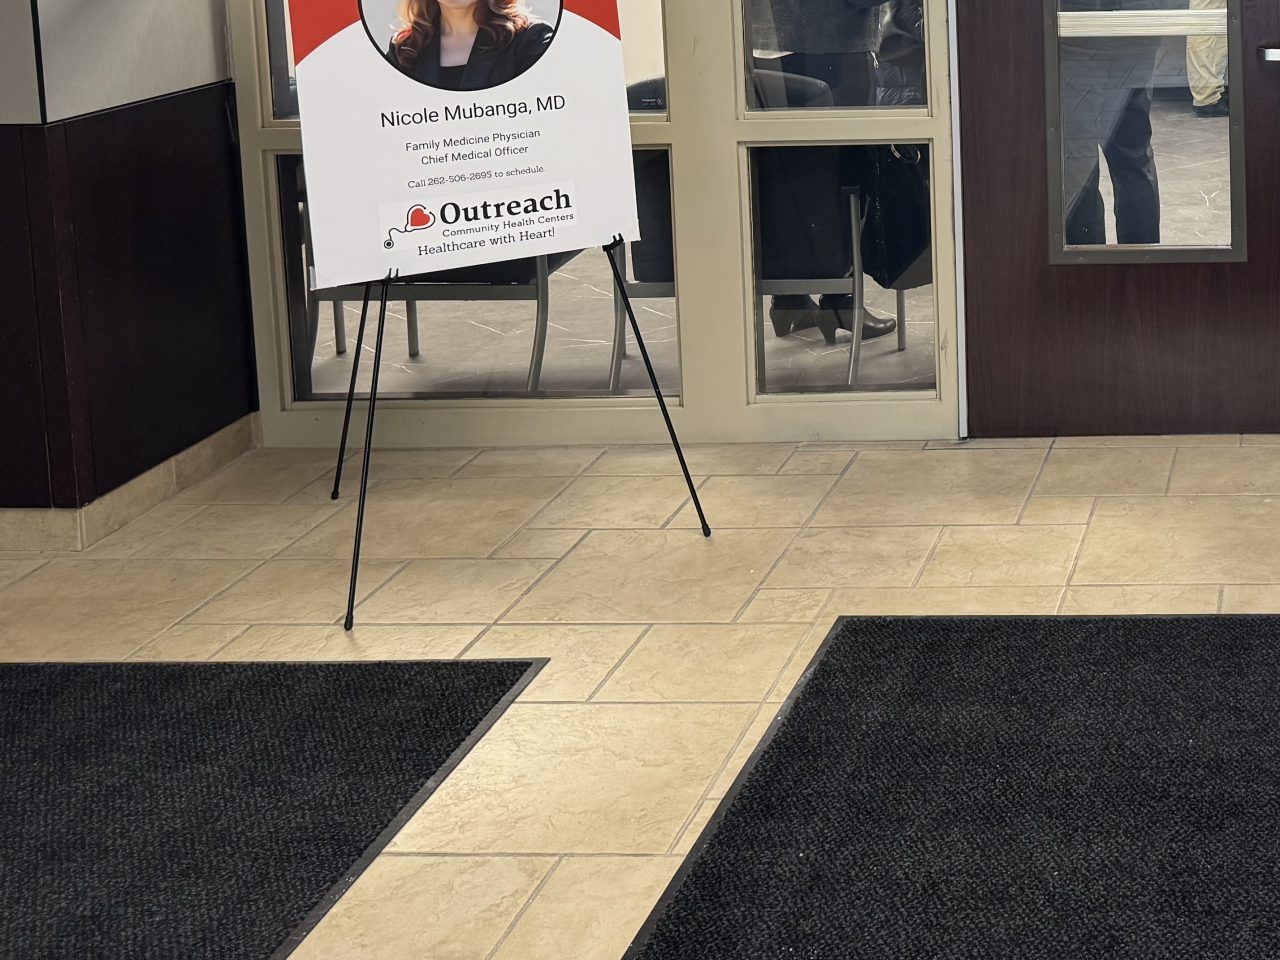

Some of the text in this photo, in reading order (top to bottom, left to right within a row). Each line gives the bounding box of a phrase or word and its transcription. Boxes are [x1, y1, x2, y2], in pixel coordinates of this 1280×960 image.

[380, 95, 566, 128] Nicole Mubanga, MD
[405, 128, 541, 152] Family Medicine Physician
[421, 144, 529, 165] Chief Medical Officer
[407, 179, 426, 189] Call
[427, 170, 493, 186] 262-506-2695
[494, 169, 504, 179] to
[440, 188, 573, 225] Outreach
[442, 212, 575, 238] Community Health Centers
[418, 227, 556, 256] Healthcare with Heart!
